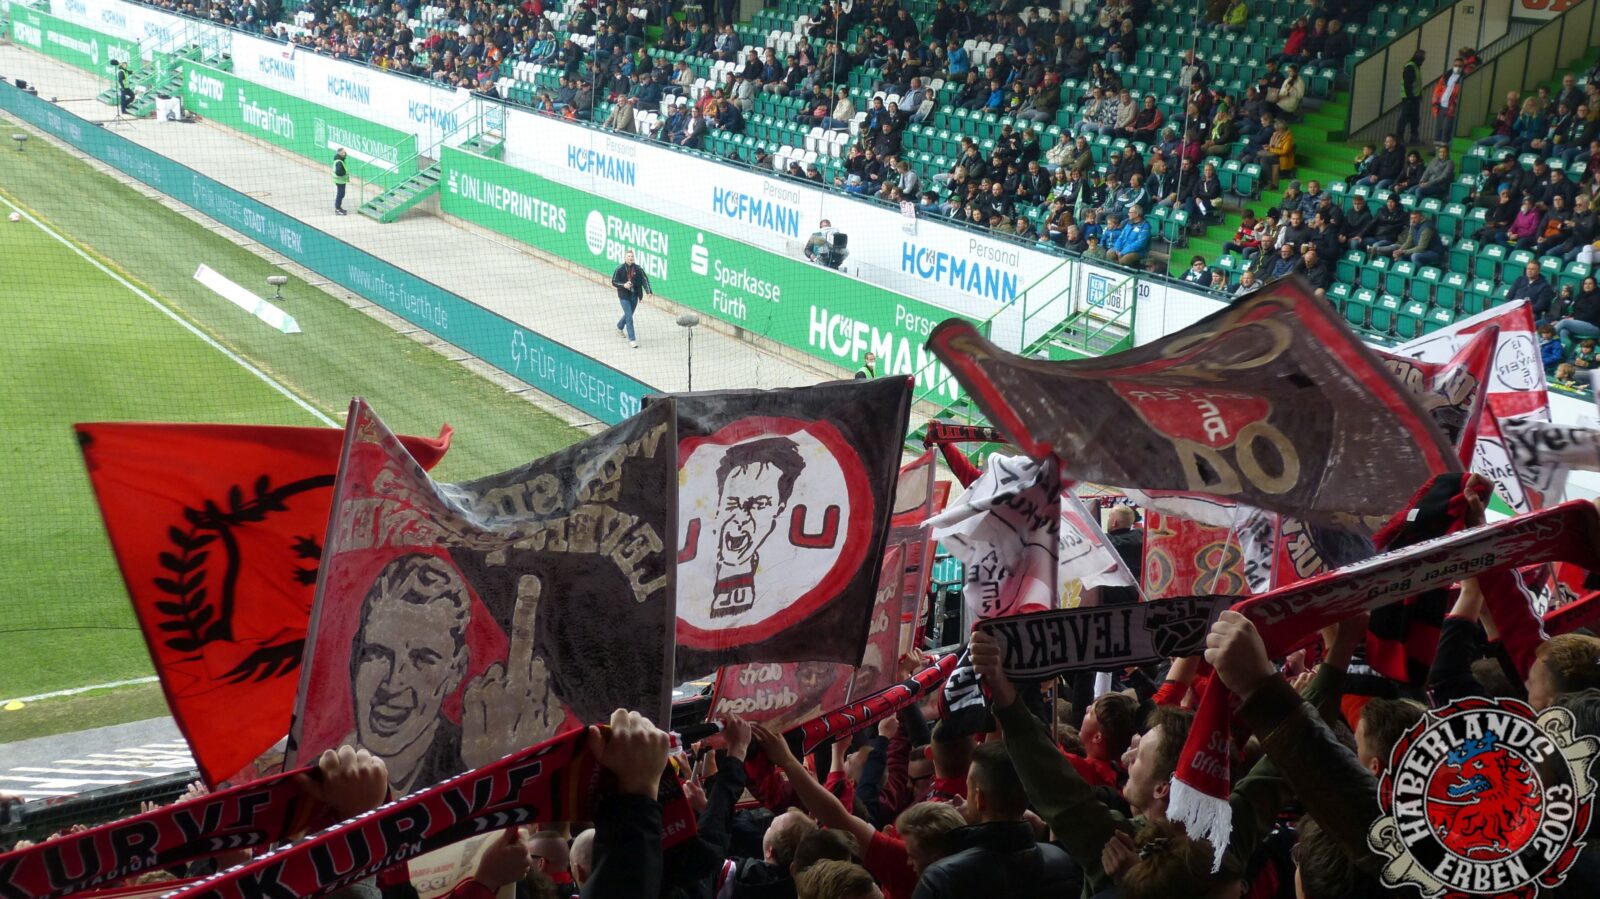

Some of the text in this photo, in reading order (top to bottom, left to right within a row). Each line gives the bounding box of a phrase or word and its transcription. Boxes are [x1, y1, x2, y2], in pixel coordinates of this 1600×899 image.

[259, 55, 295, 81] HOFMANN
[327, 74, 370, 105] HOFMANN
[409, 99, 458, 131] HOFMANN
[327, 124, 361, 151] THOMAS
[567, 143, 636, 187] HOFMANN
[461, 173, 567, 233] ONLINEPRINTERS
[763, 180, 801, 205] Personal
[713, 186, 799, 238] HOFMANN
[607, 214, 669, 257] FRANKEN
[969, 237, 1020, 269] Personal
[713, 259, 781, 303] Sparkasse
[902, 241, 1018, 306] HOFMANN
[713, 288, 747, 321] Fürth
[1138, 284, 1151, 298] 10
[809, 304, 960, 401] HOFMANN
[530, 346, 556, 380] FÜR
[559, 364, 616, 413] UNSERE
[1367, 578, 1411, 599] Berg
